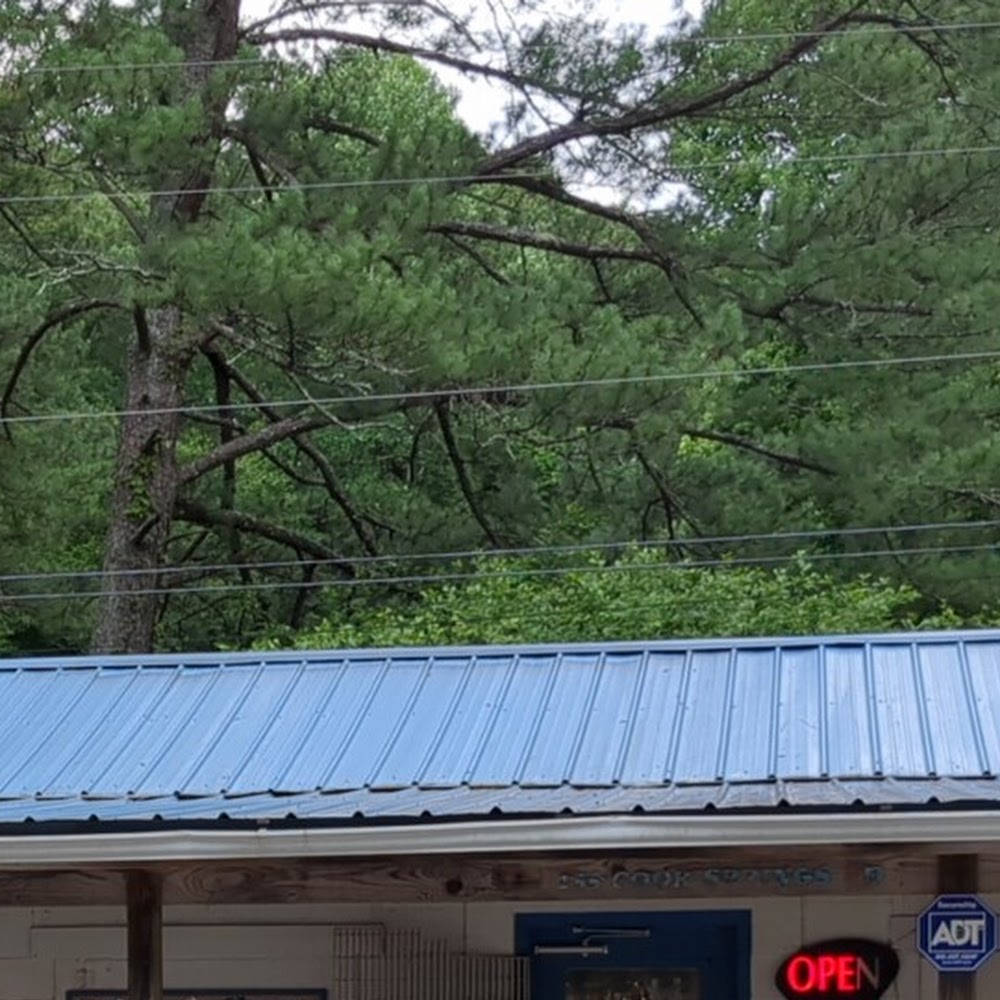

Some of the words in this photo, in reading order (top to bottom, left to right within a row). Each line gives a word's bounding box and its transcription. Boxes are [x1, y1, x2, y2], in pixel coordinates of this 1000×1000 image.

[611, 870, 692, 889] COOK
[931, 918, 986, 947] ADT
[785, 954, 880, 993] OPEN
